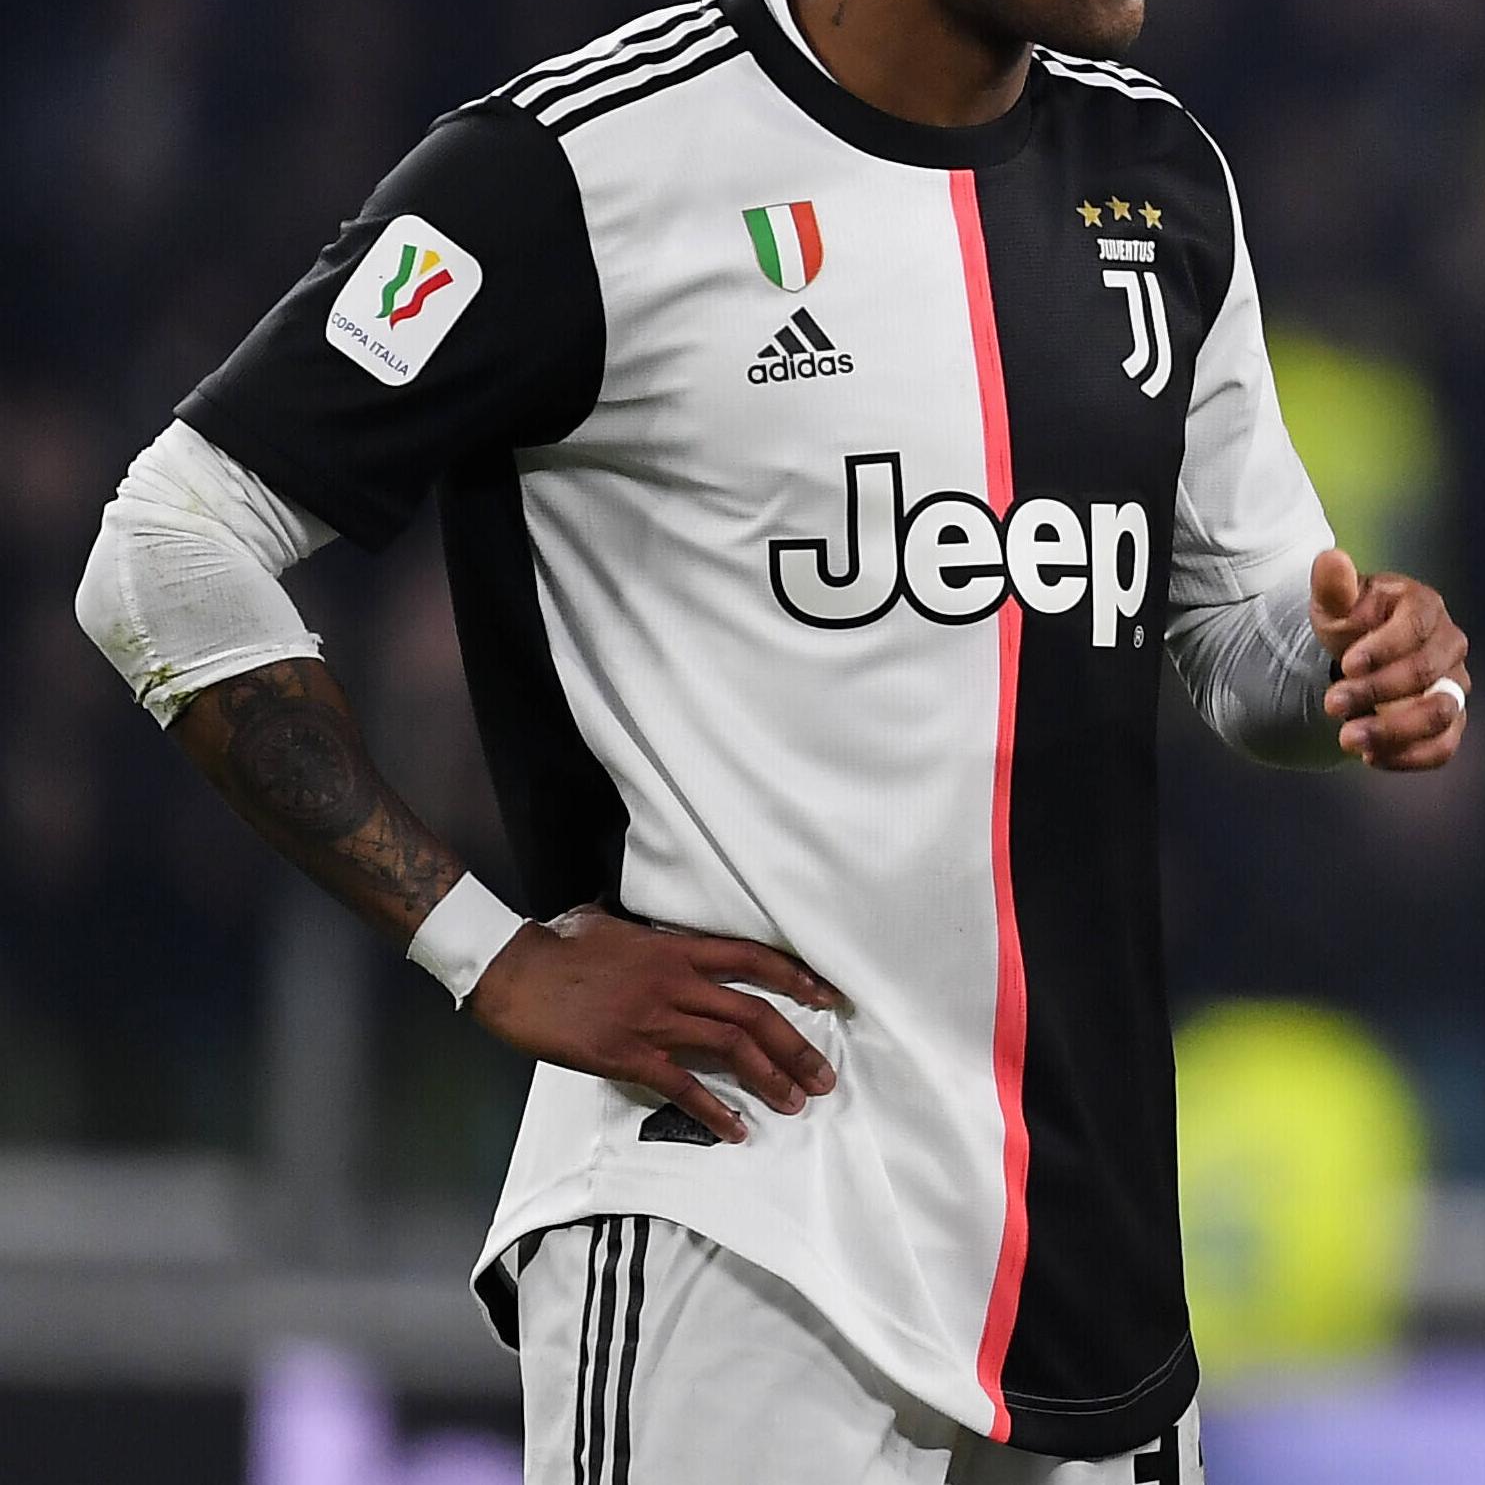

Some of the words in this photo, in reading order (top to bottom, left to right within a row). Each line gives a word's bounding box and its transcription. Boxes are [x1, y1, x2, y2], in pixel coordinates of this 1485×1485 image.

[1096, 238, 1156, 262] JUVENTUS
[331, 312, 369, 347] COPPA
[369, 340, 409, 376] ITALIA
[747, 352, 854, 384] adidas
[768, 452, 1150, 648] Jeep
